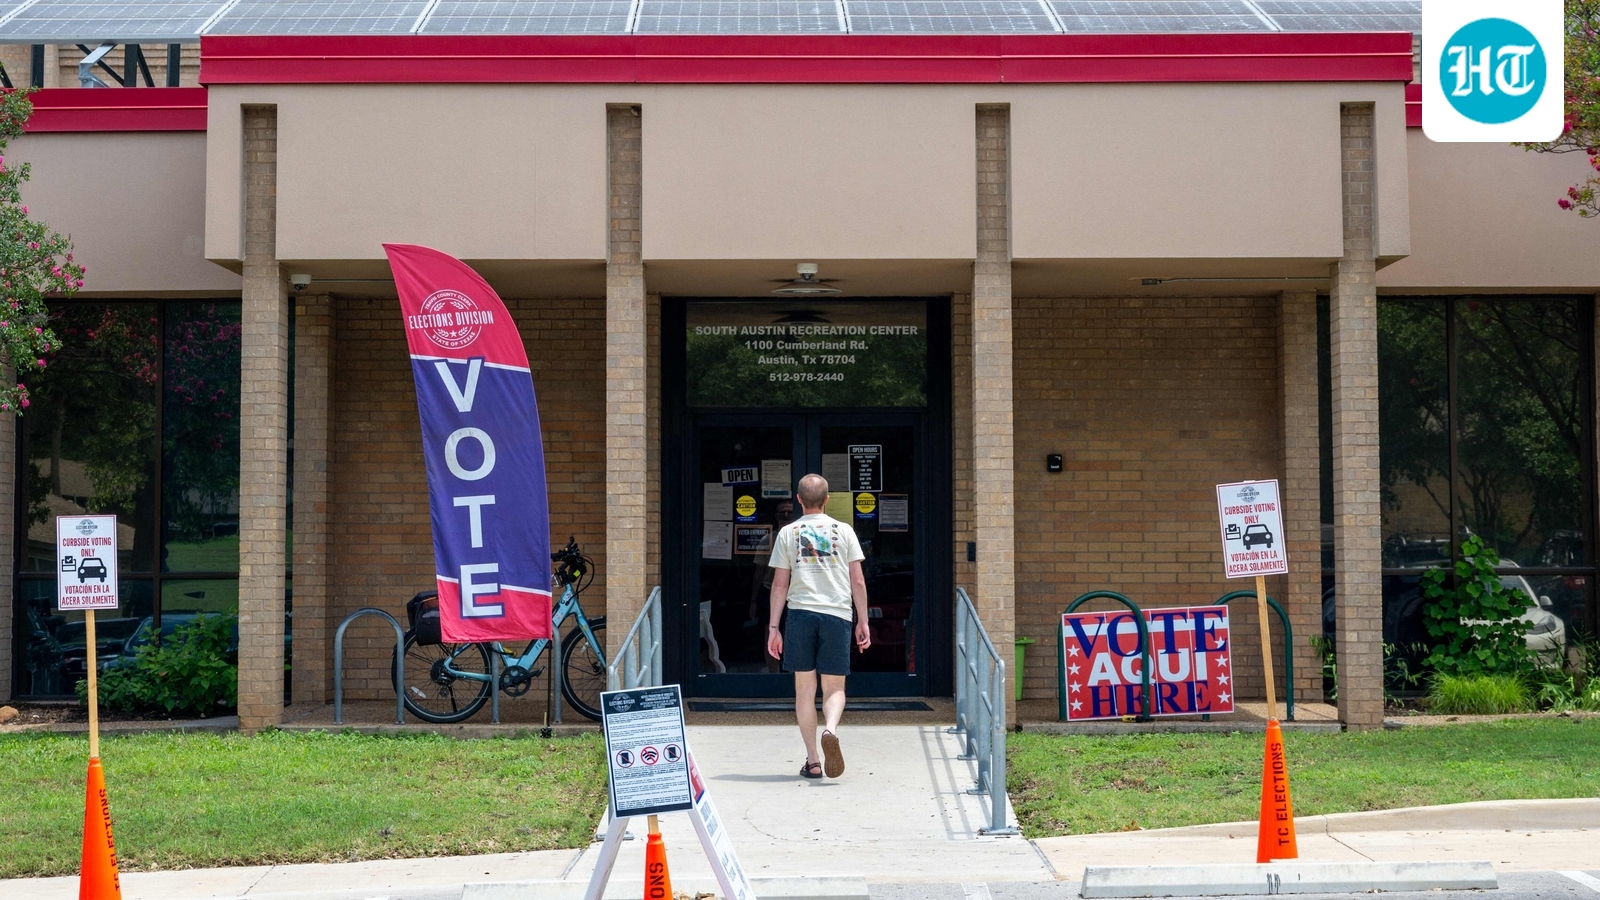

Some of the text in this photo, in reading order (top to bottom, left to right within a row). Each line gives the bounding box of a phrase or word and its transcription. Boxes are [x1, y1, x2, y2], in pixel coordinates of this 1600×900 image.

[424, 296, 438, 310] TRAVIS
[457, 294, 473, 307] CLERK
[408, 310, 494, 330] ELECTIONS DIVISION
[695, 325, 918, 336] SOUTH AUSTIN RECREATION CENTER
[431, 334, 449, 346] STATE
[459, 331, 476, 345] TEXAS
[744, 340, 869, 350] 1100 Cumberland Rd.
[757, 355, 856, 366] Austin, Tx 78704
[769, 373, 844, 382] 512-978-2440
[727, 468, 754, 482] OPEN
[434, 359, 504, 617] VOTE
[1224, 502, 1276, 515] CURBSIDE VOTING
[1244, 515, 1259, 525] ONLY
[62, 537, 112, 547] CURBSIDE VOTING
[80, 548, 96, 557] ONLY
[1230, 550, 1278, 562] VOTACIÓN EN LA
[1229, 560, 1284, 573] ACERA SOLAMENTE
[64, 583, 110, 595] VOTACIÓN EN LA
[61, 595, 115, 606] ACERA SOLAMENTE
[1065, 610, 1228, 660] VOTE
[1087, 647, 1208, 686] AQUI
[1089, 680, 1212, 718] HERE
[1270, 742, 1290, 847] TC ELECTIONS
[98, 788, 117, 867] ELECTIONS
[648, 862, 665, 899] ONS
